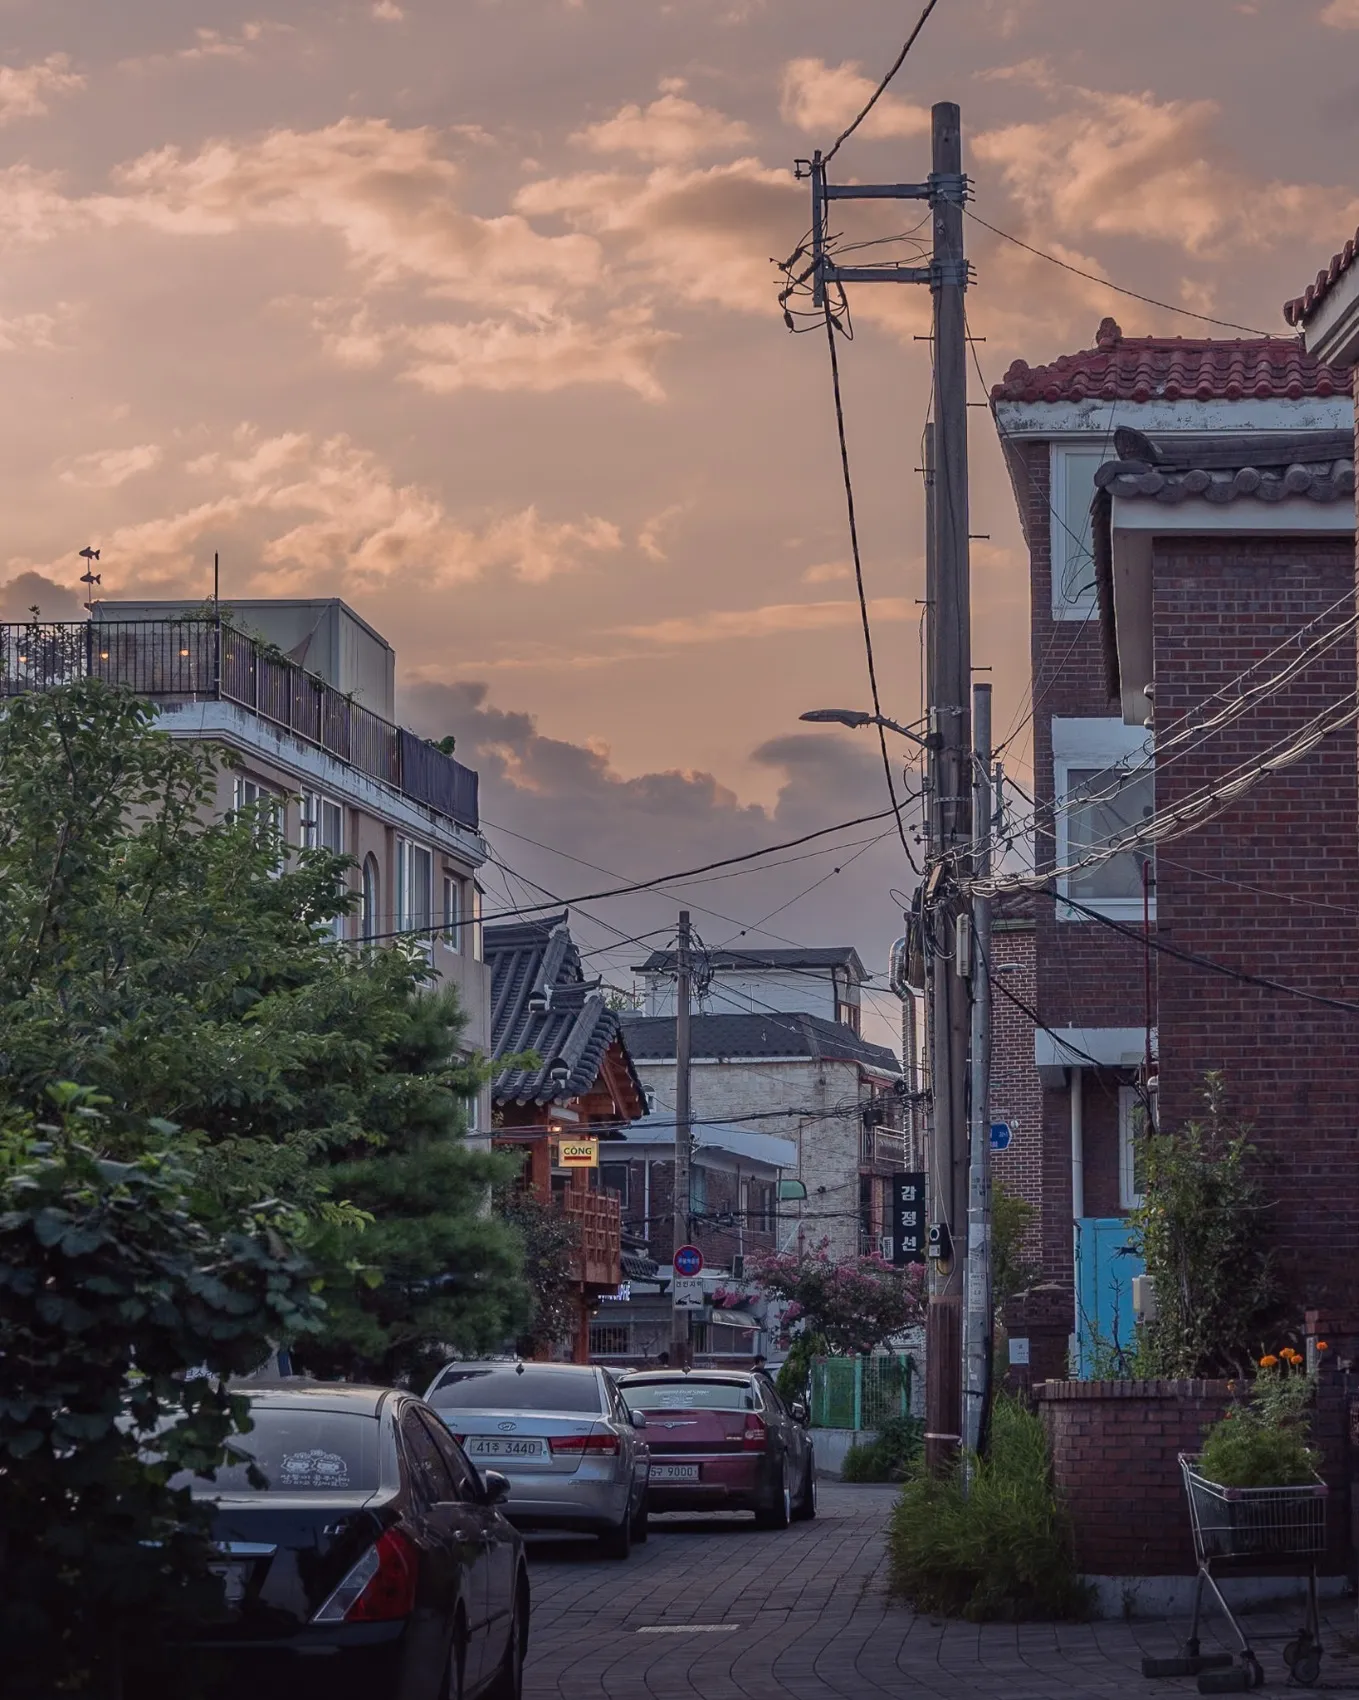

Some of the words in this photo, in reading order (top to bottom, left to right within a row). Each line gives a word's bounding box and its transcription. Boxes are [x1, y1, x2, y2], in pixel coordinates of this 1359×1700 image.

[901, 1185, 917, 1252] 감정선
[476, 1441, 500, 1453] 41주
[505, 1442, 536, 1454] 3440
[650, 1466, 663, 1477] 5구
[667, 1466, 693, 1477] 9000
